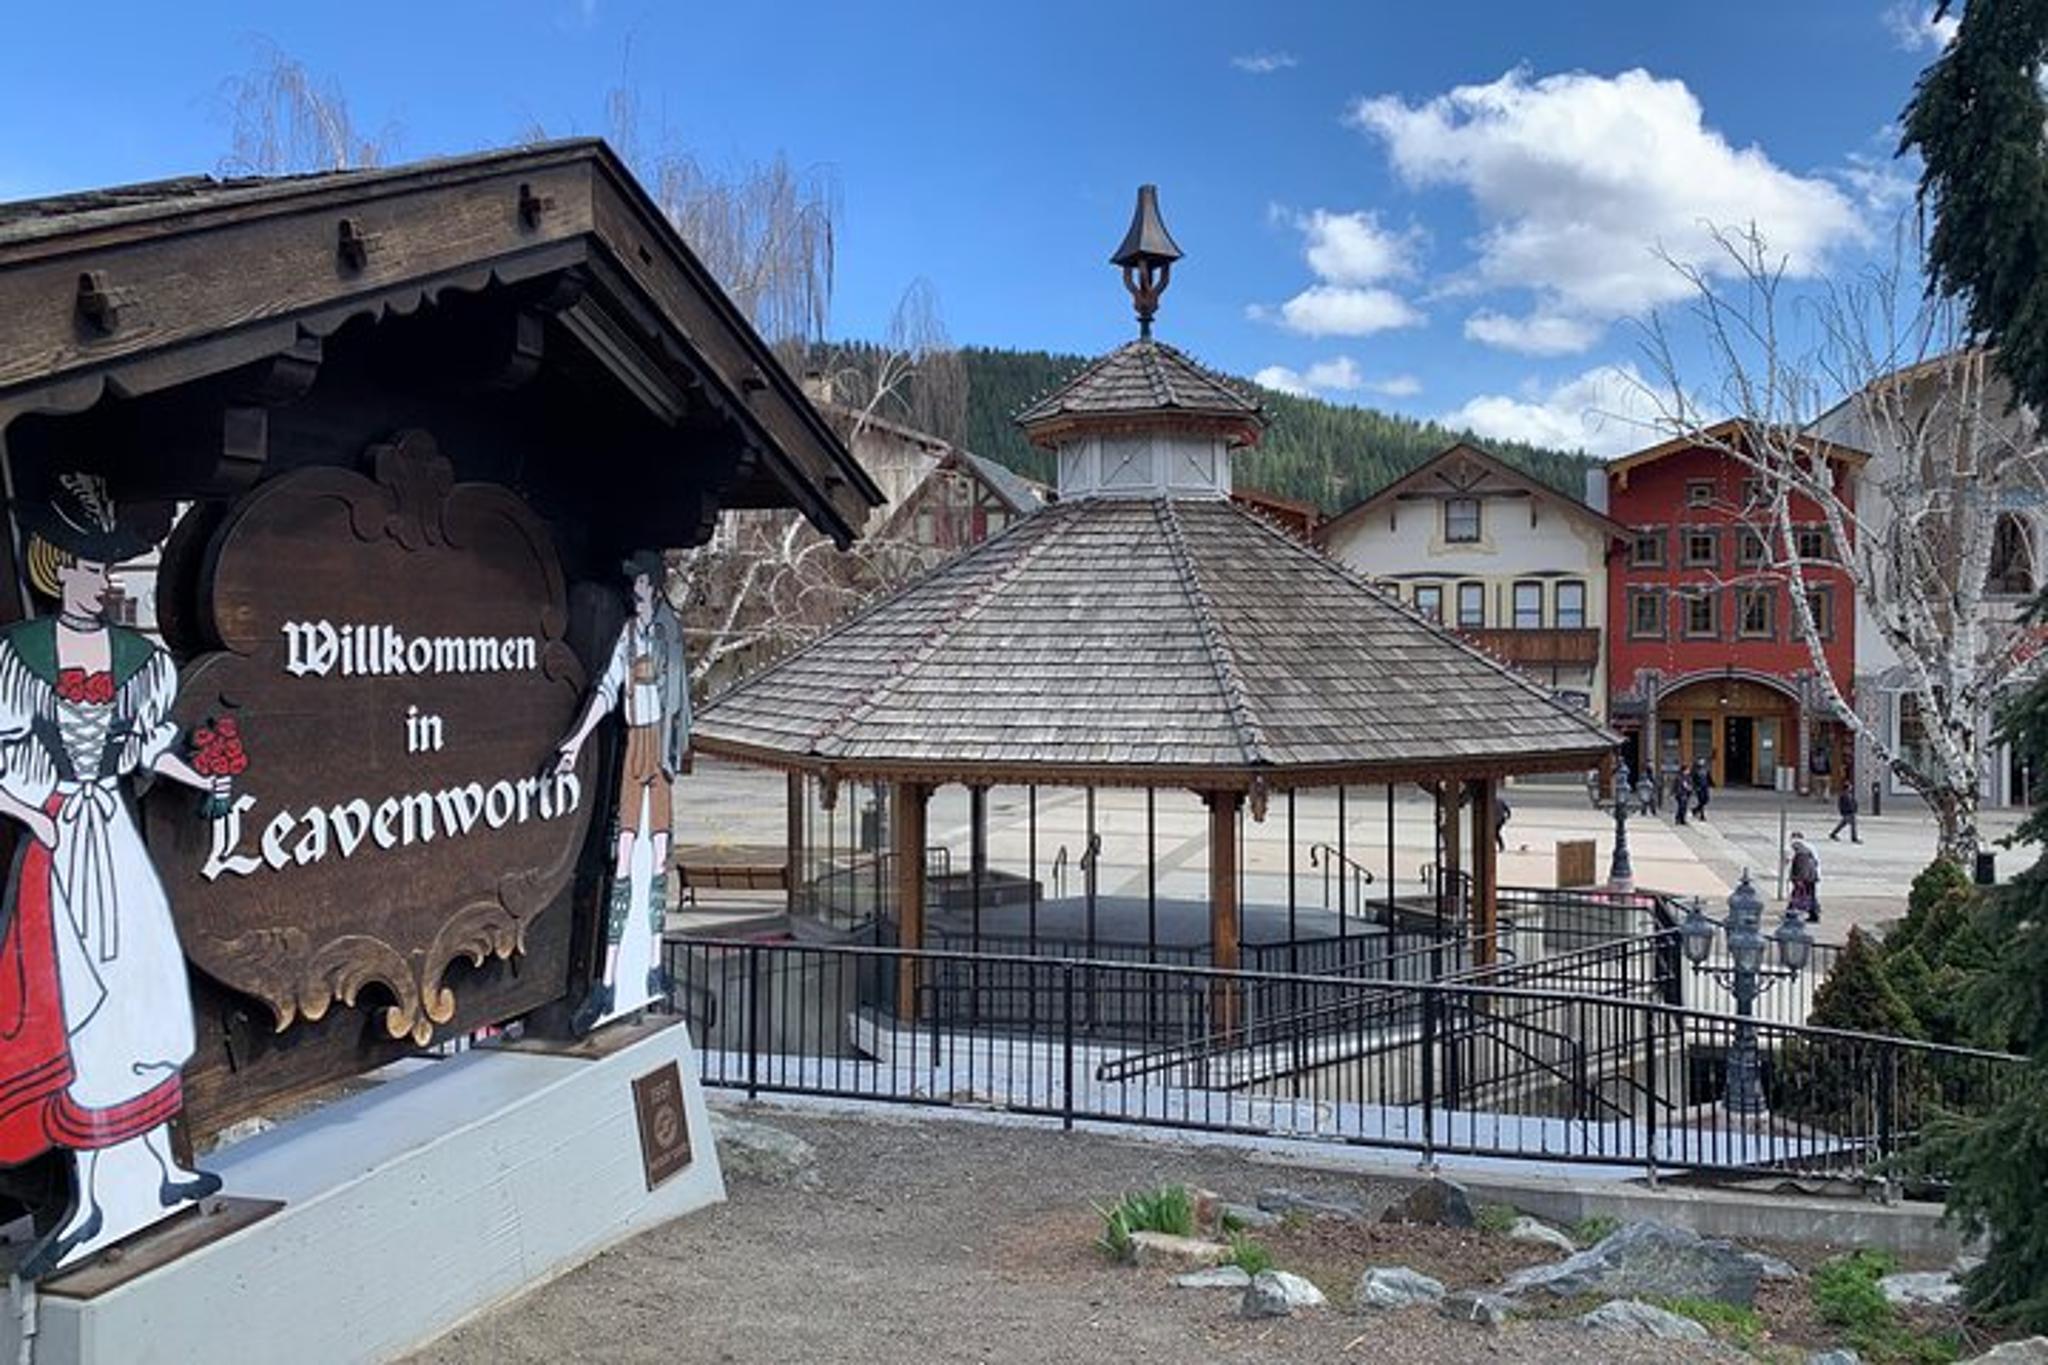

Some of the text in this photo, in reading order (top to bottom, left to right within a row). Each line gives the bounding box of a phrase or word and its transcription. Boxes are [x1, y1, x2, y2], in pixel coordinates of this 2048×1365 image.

[282, 619, 538, 677] Willkommen
[406, 705, 445, 752] in
[200, 771, 582, 882] Leavenworth
